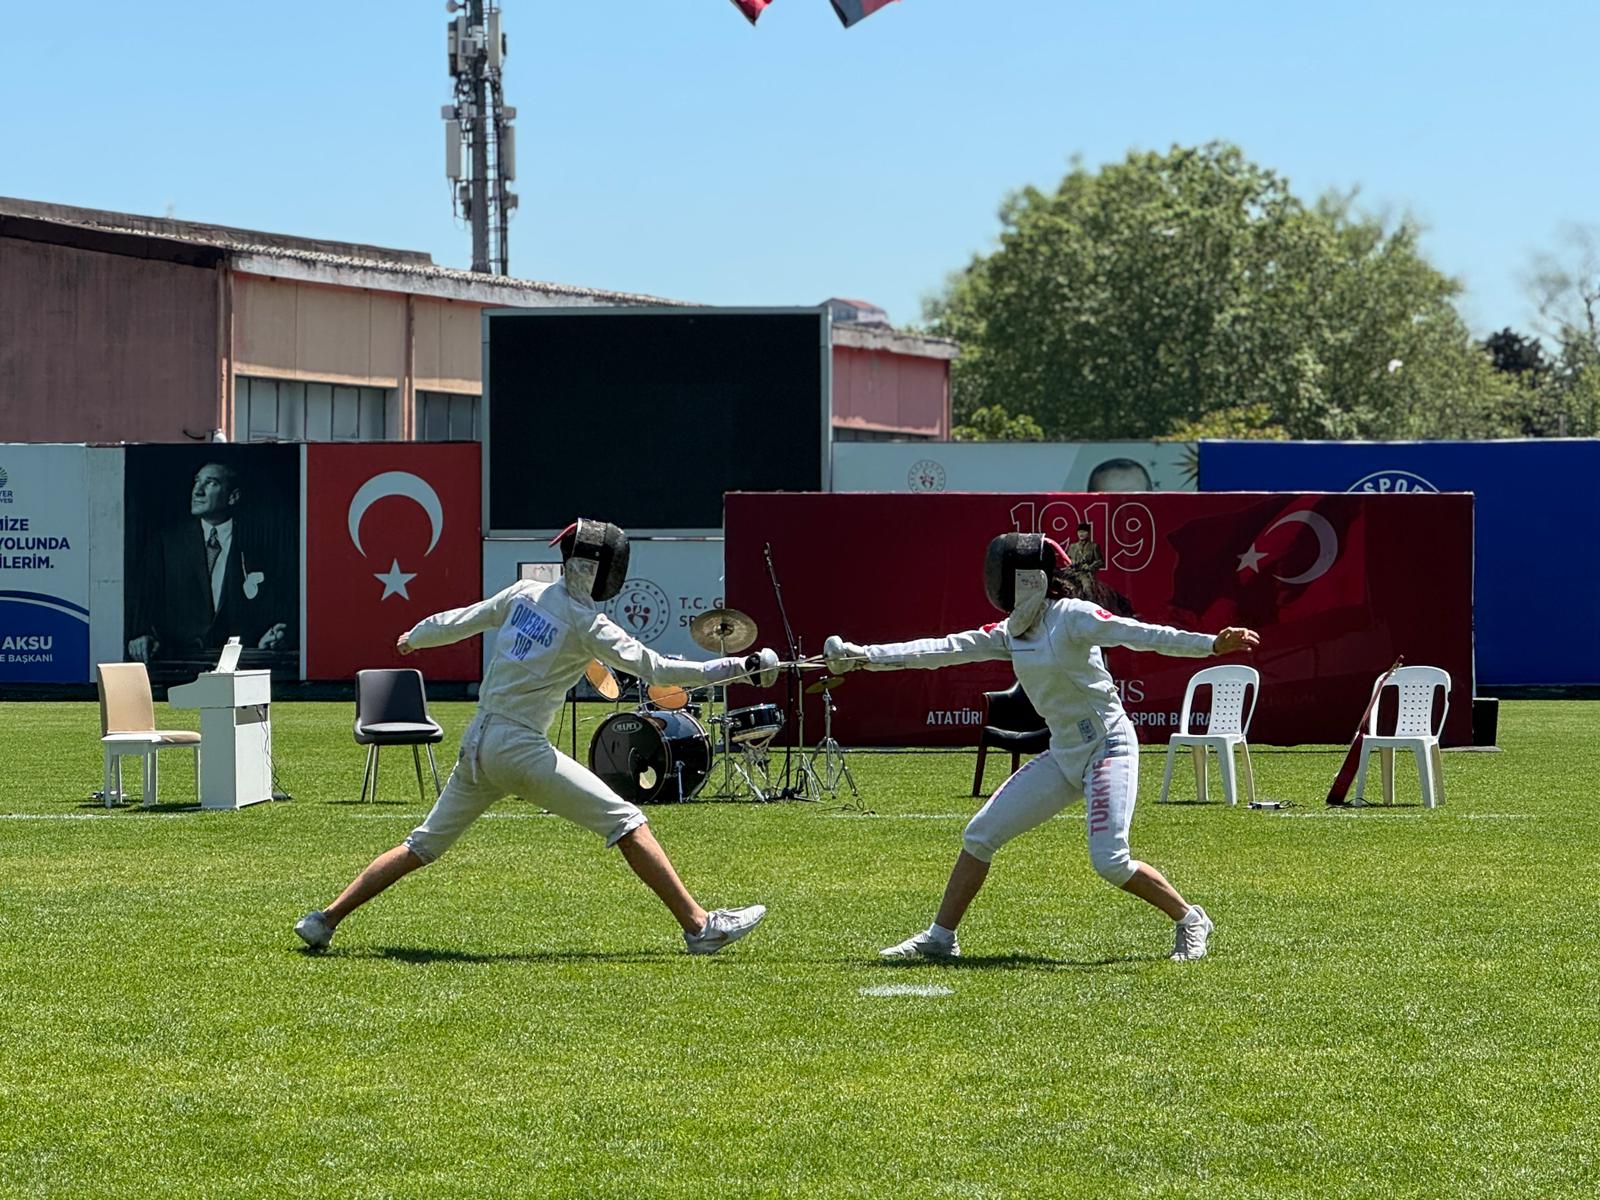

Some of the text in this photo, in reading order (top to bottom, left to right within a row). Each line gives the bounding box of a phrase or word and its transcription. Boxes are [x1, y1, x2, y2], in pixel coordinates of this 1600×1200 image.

[1010, 501, 1156, 572] 1919
[679, 597, 707, 609] T.C.
[679, 615, 697, 627] SP
[1, 635, 53, 650] AKSU
[511, 632, 533, 660] TUR
[8, 653, 53, 664] BAŞKANI
[1131, 712, 1166, 726] SPOR
